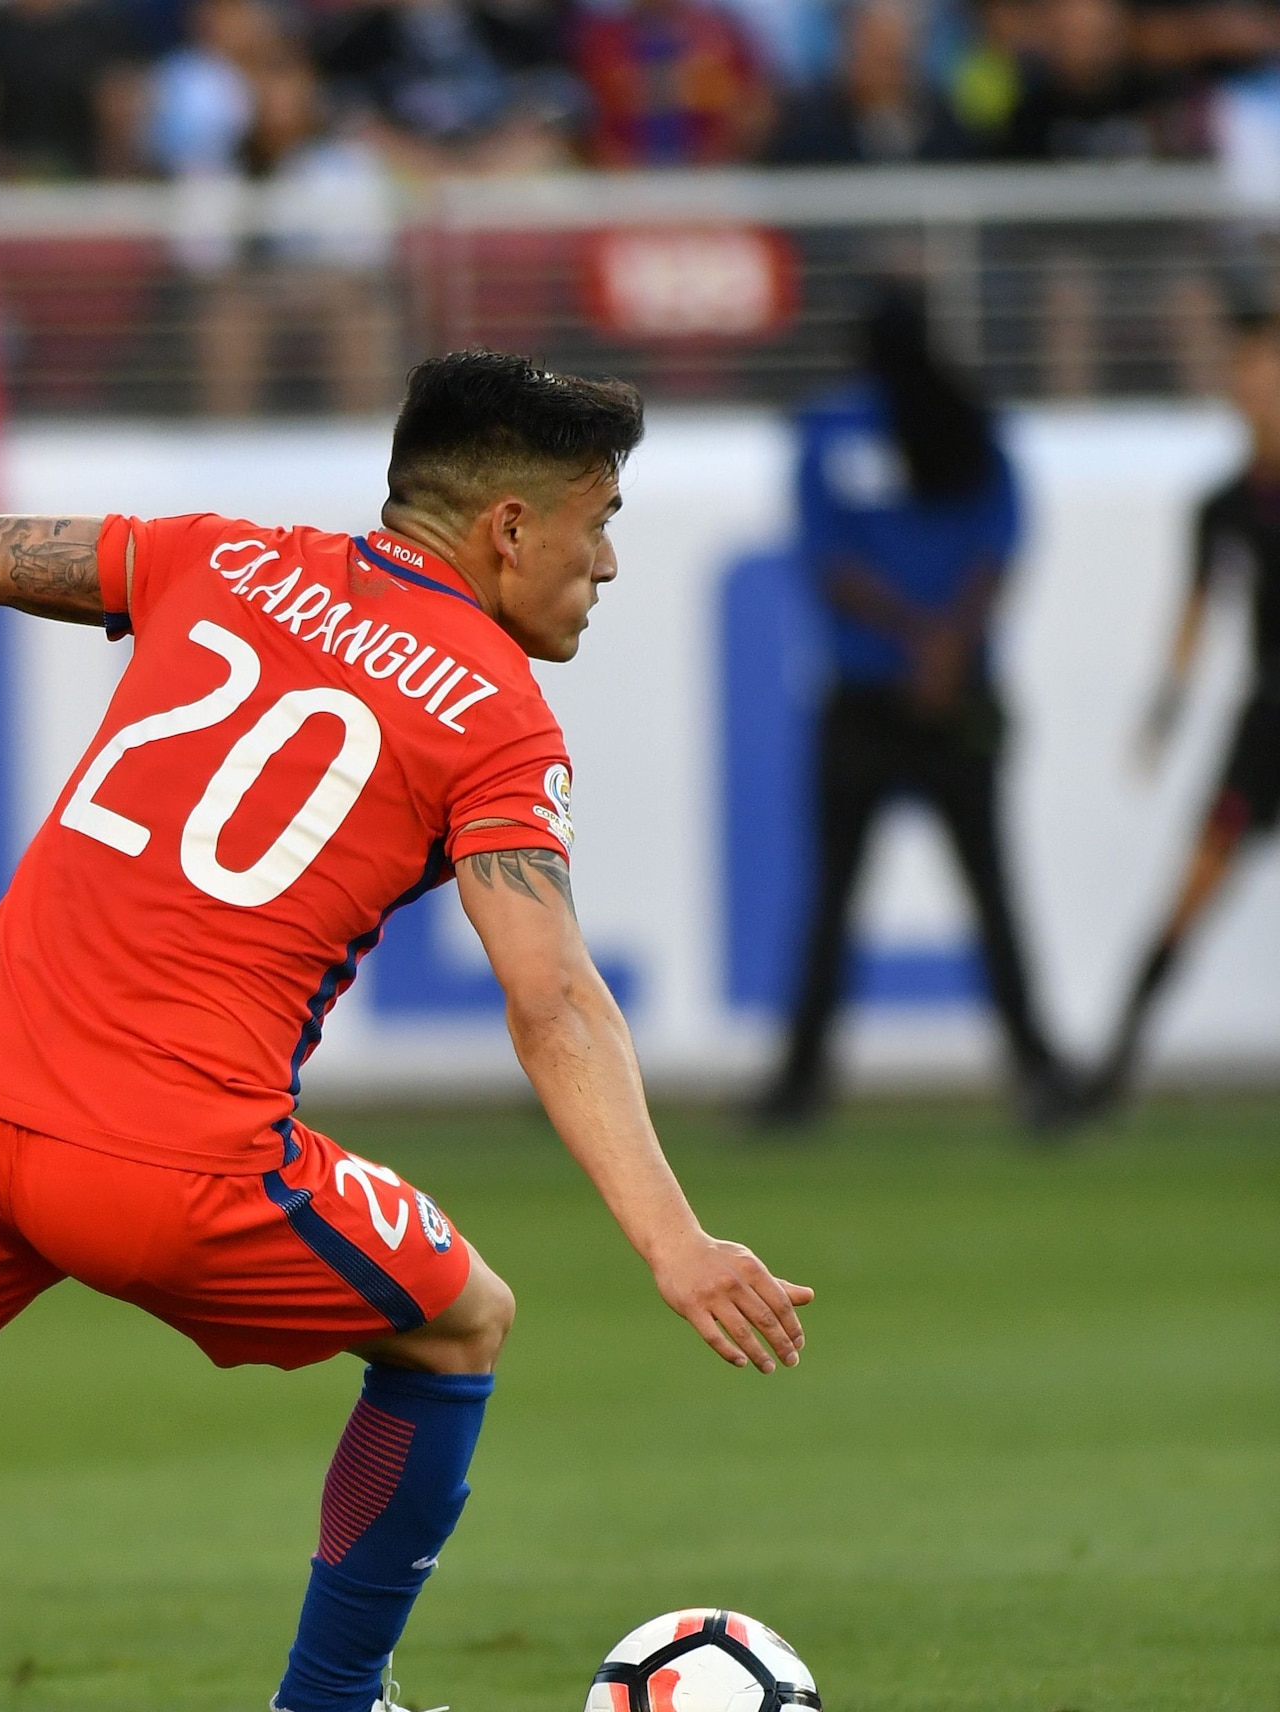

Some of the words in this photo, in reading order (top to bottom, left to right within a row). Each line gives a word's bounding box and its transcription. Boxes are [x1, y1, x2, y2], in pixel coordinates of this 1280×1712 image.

[376, 538, 391, 554] LA
[393, 545, 424, 569] ROJA
[59, 619, 382, 908] 20
